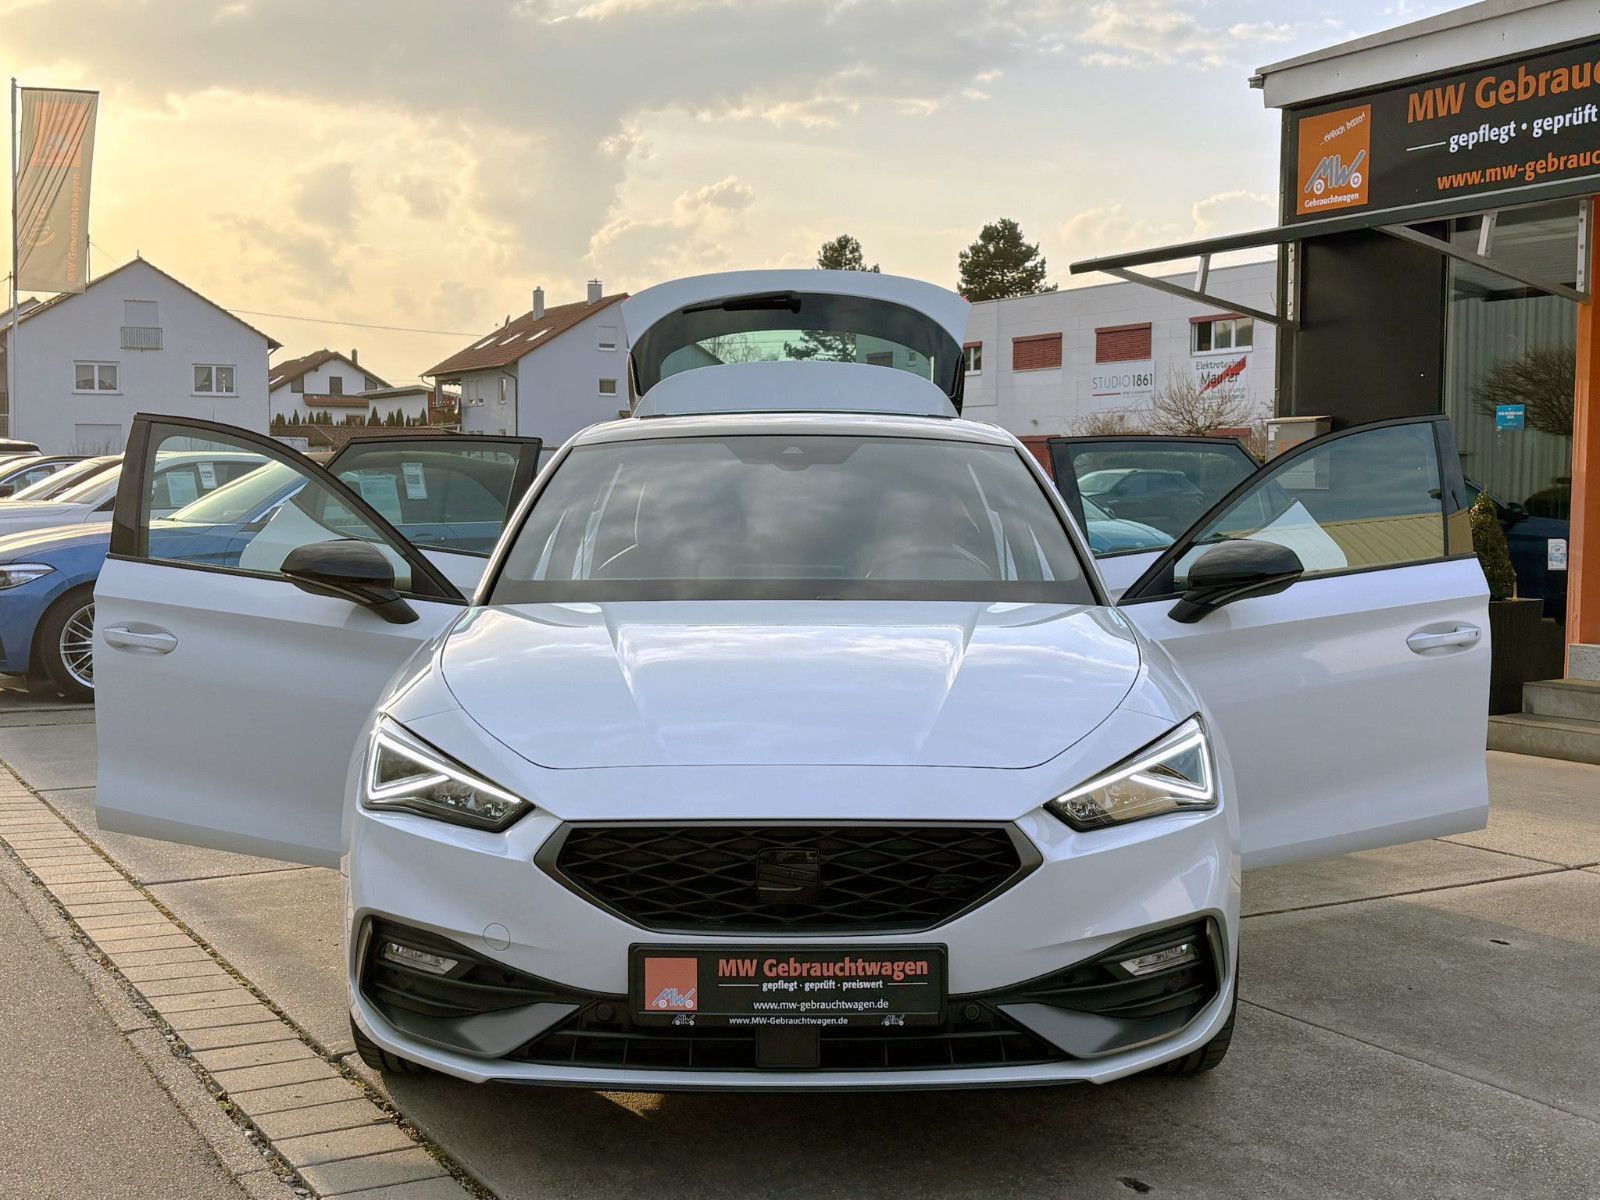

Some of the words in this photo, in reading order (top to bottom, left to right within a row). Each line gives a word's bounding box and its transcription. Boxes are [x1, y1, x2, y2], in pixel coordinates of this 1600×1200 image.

[1408, 82, 1466, 123] MW
[1449, 121, 1516, 153] gepflegt
[1532, 104, 1598, 137] geprüft
[1304, 193, 1359, 208] Gebrauchtwagen
[718, 959, 757, 977] MW
[763, 956, 928, 981] Gebrauchtwagen
[762, 980, 797, 991] gepflegt
[804, 980, 836, 991] geprüft
[842, 979, 883, 991] preiswert
[753, 999, 889, 1011] www.mw-gebrauchtwagen.de
[729, 1016, 848, 1026] www.MW-Gebrauchtwagen.de
